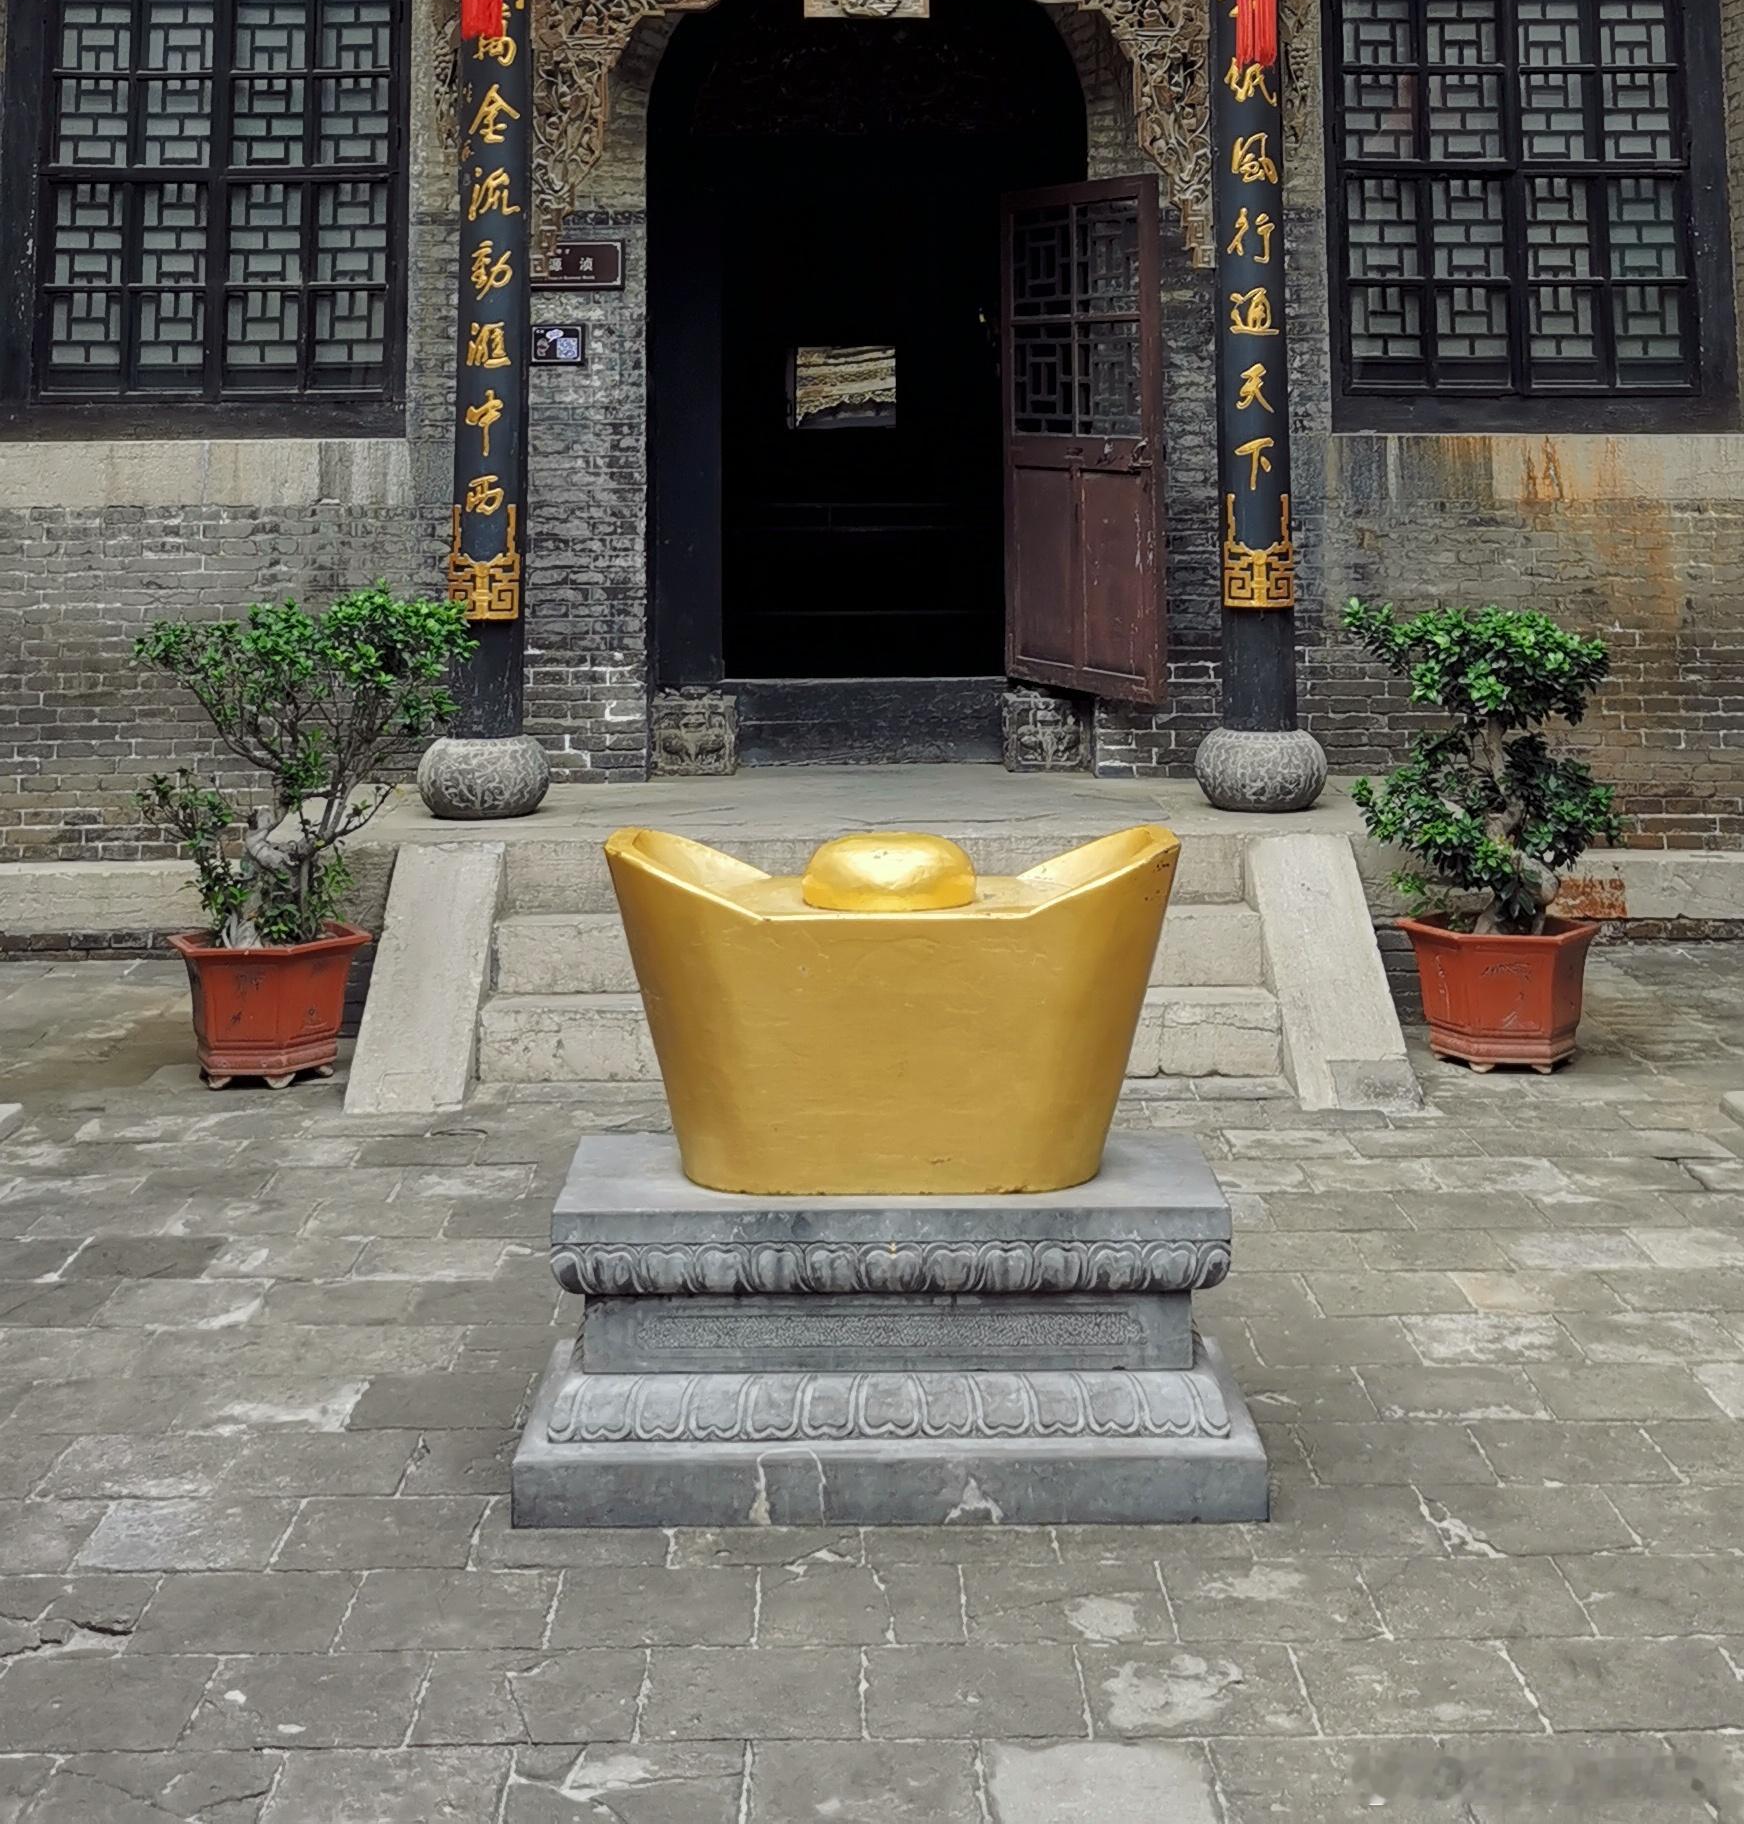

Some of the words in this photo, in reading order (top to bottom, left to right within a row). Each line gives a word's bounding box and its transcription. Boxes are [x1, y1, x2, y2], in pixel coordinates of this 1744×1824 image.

[1225, 2, 1280, 491] 紙風行通天下
